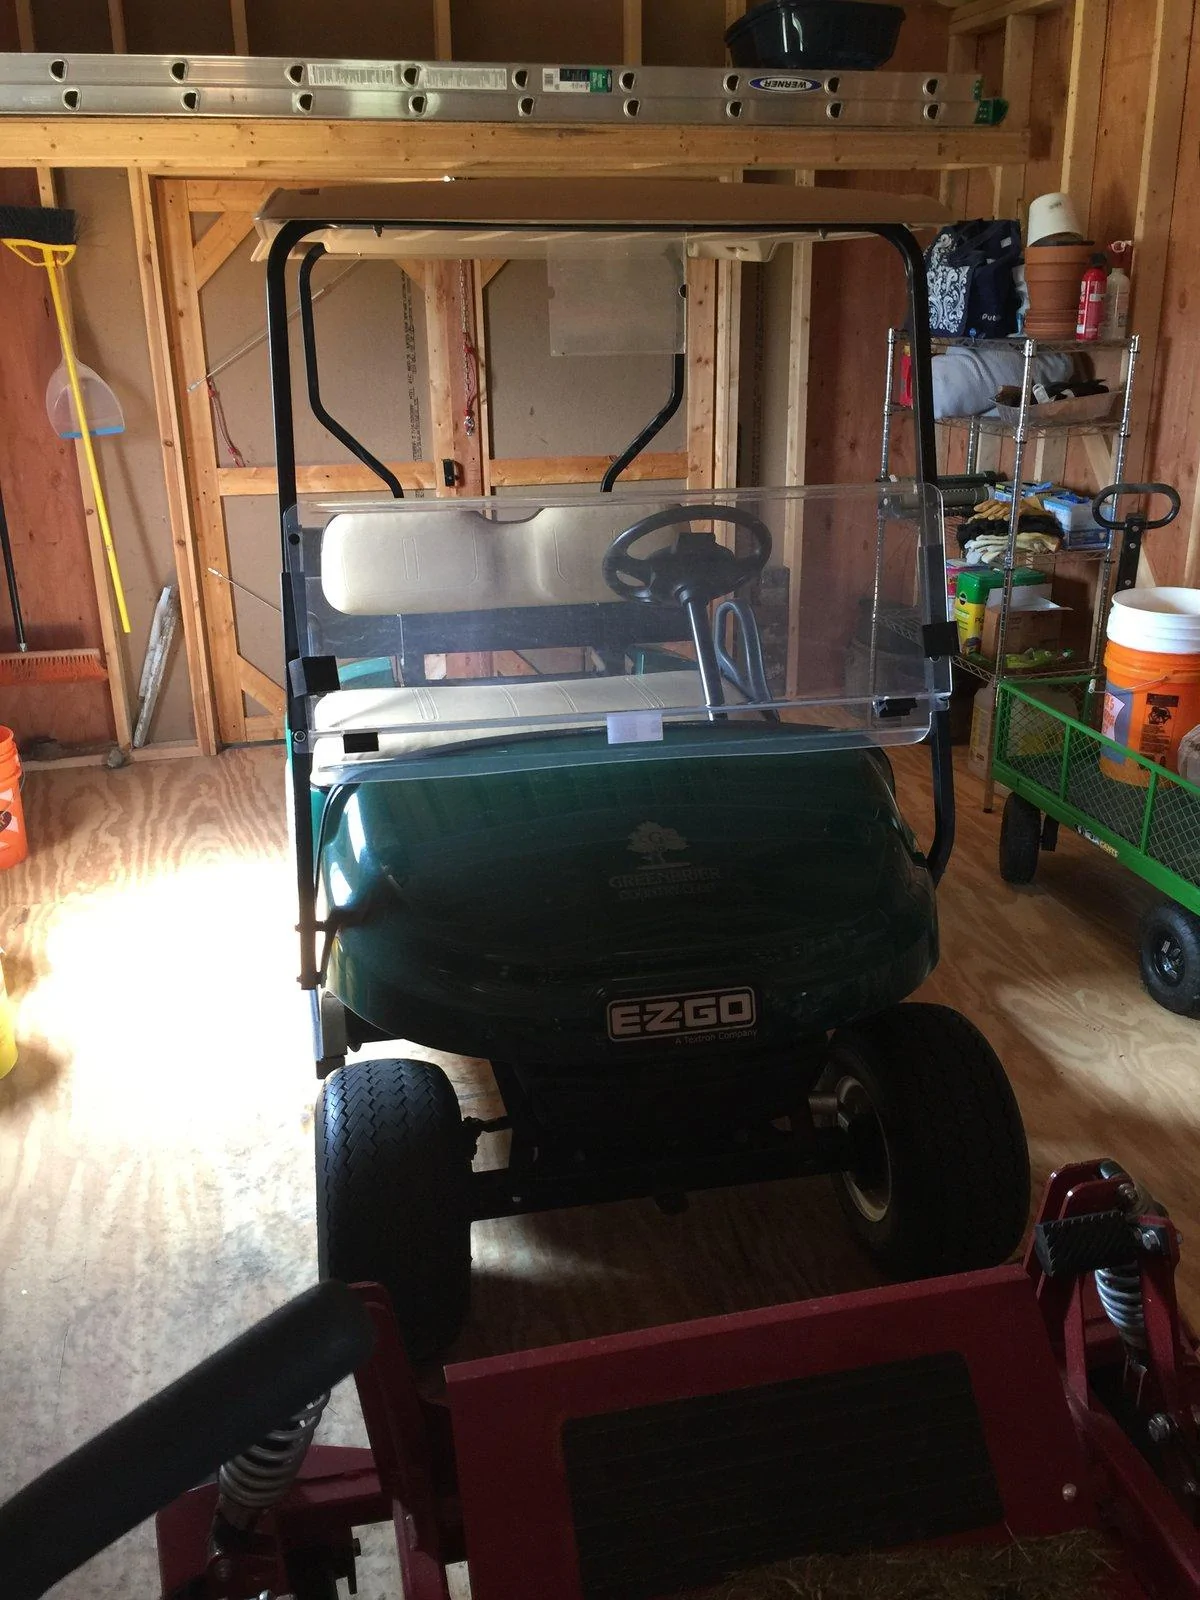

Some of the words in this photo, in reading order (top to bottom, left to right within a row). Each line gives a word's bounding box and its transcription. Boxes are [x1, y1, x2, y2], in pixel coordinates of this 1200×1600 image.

[764, 80, 806, 88] WERNER
[685, 1033, 715, 1044] Textron
[719, 1029, 758, 1041] Company
